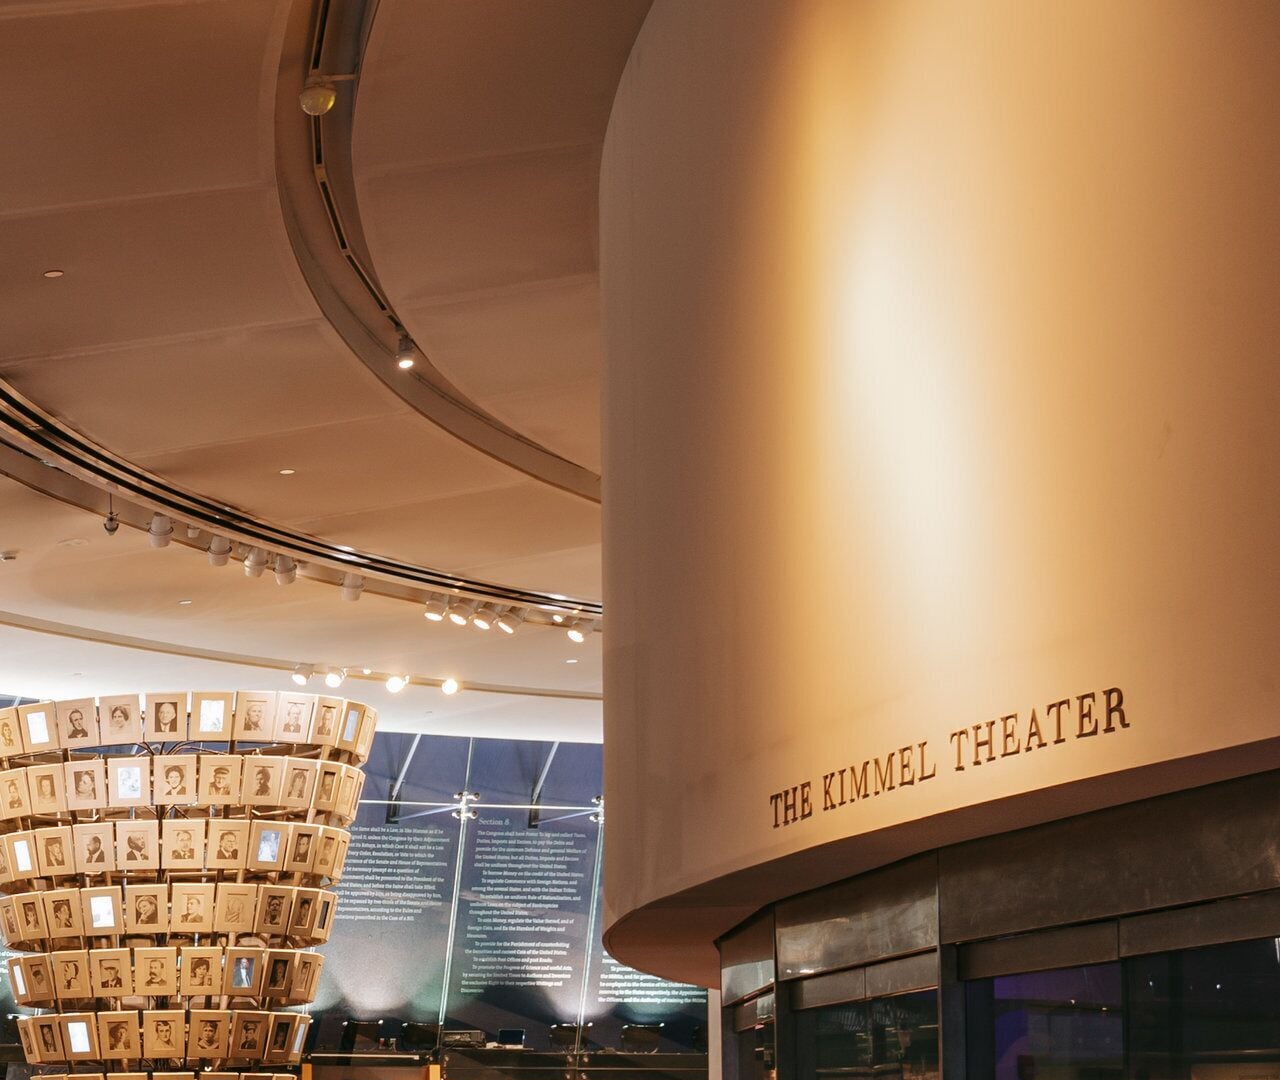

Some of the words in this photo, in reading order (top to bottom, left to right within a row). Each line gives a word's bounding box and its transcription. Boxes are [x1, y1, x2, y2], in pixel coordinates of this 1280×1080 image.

[770, 781, 812, 828] THE
[822, 741, 936, 811] KIMMEL
[950, 687, 1130, 772] THEATER
